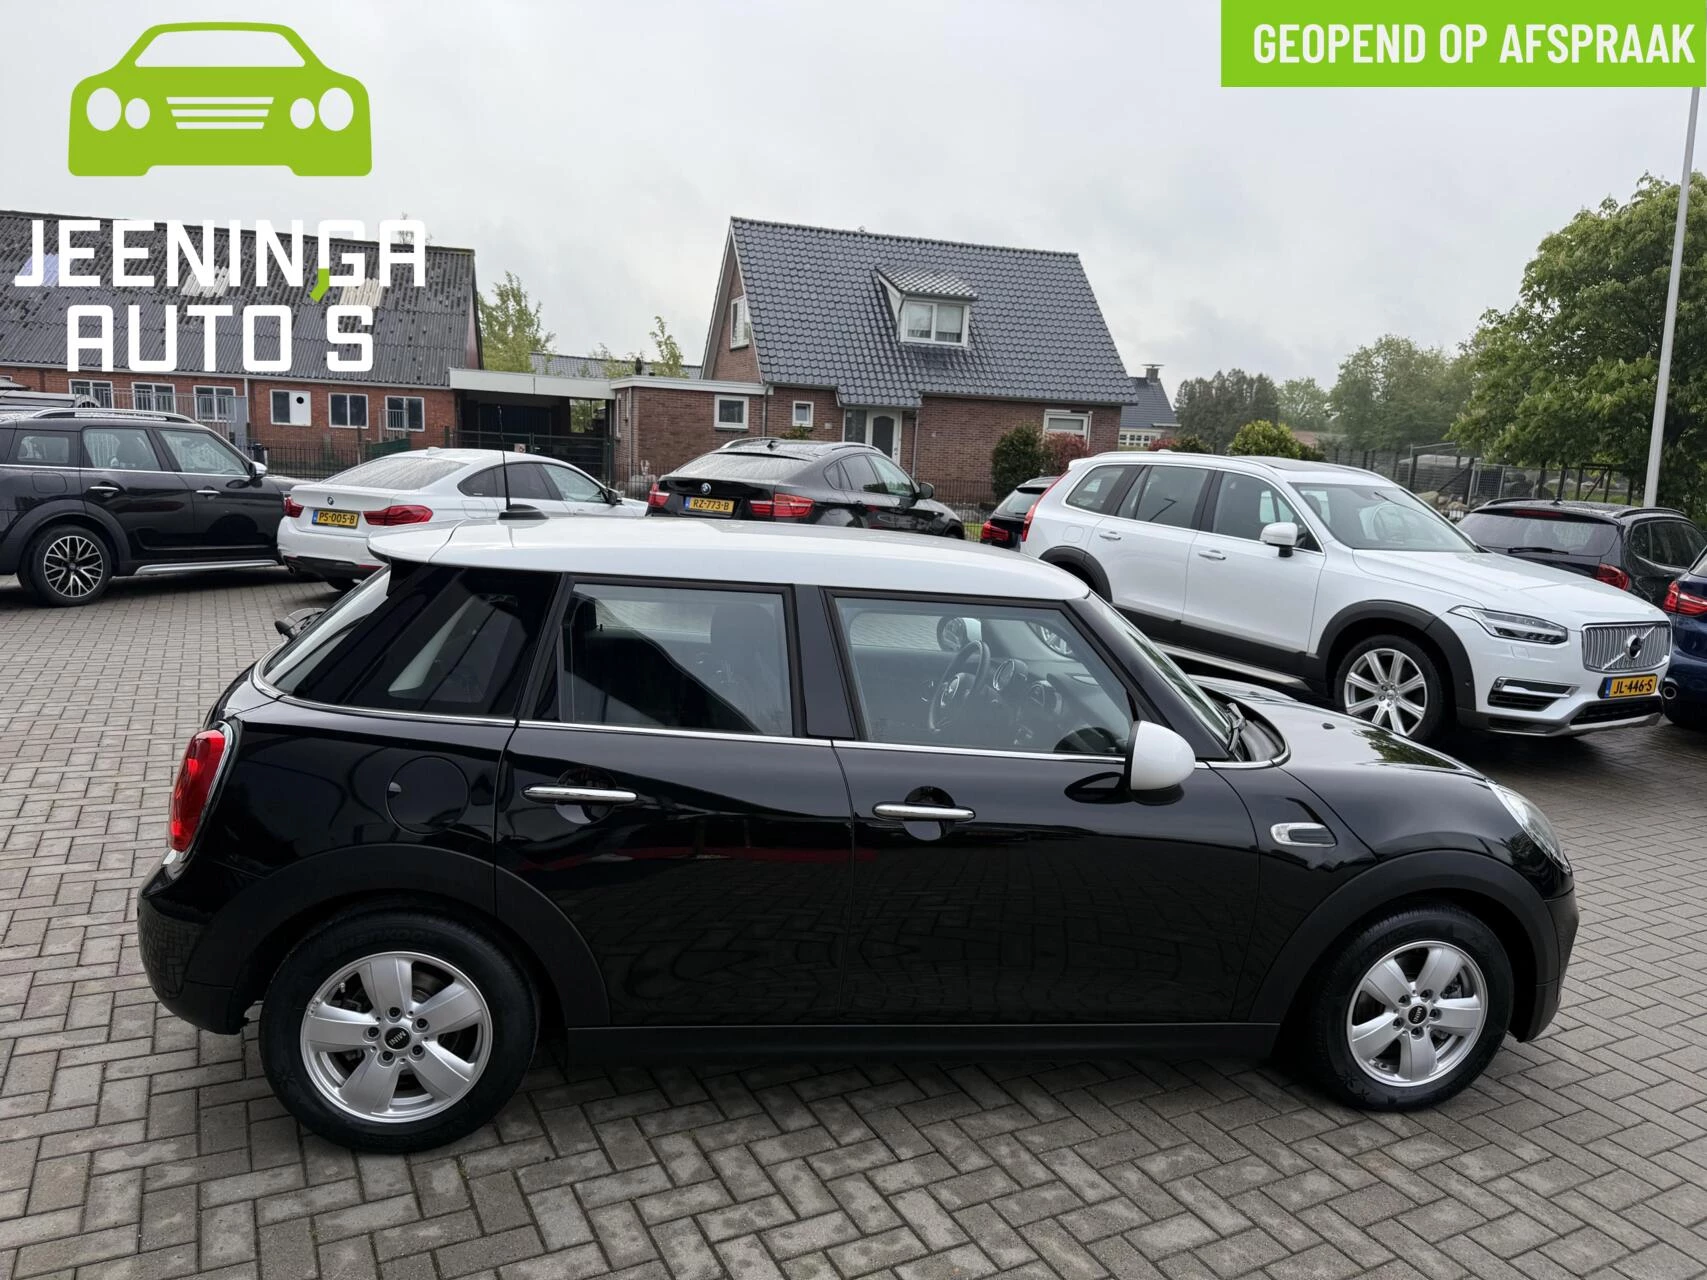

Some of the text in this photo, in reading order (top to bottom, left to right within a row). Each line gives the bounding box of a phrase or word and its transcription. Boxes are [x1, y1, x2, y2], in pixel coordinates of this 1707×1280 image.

[693, 498, 730, 511] RZ-773-B
[319, 512, 355, 525] PS-005-B
[1613, 678, 1653, 695] JL-446-S
[388, 1030, 407, 1047] MINI
